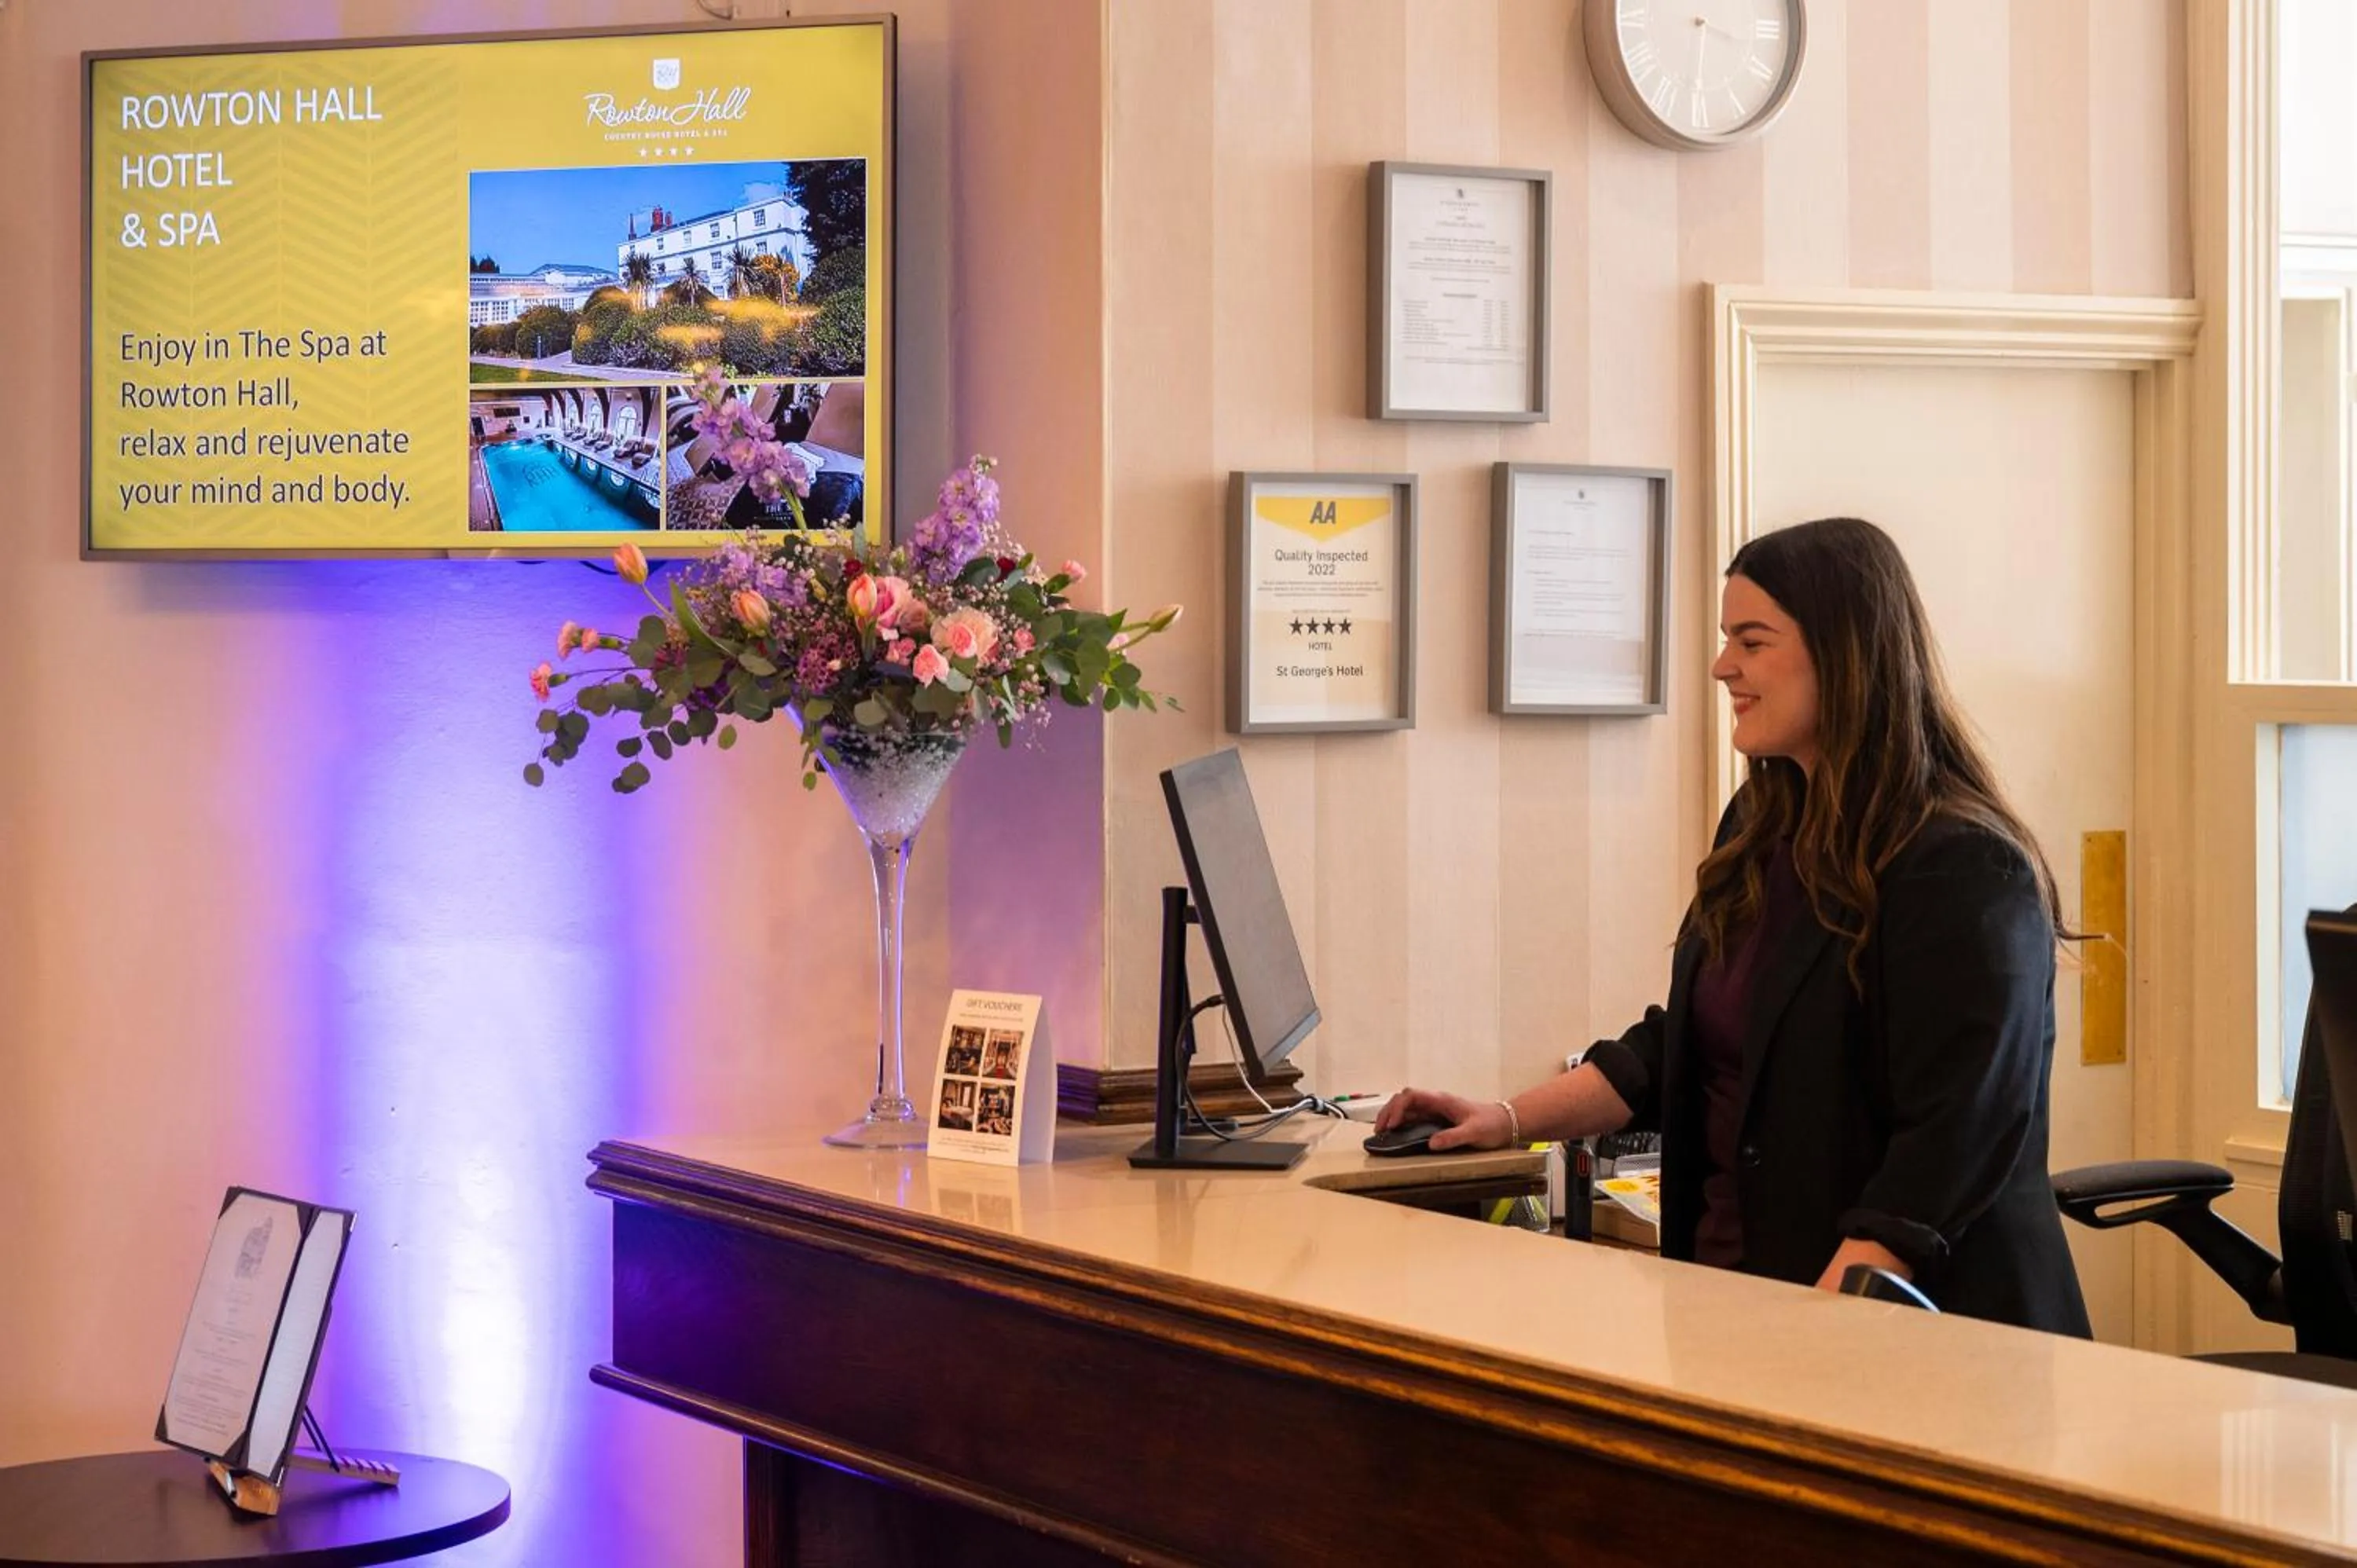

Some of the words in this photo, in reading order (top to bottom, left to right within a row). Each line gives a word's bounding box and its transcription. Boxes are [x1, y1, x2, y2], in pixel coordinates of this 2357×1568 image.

[121, 90, 280, 130] ROWTON
[295, 86, 383, 123] HALL
[583, 93, 669, 127] Rowton
[669, 87, 751, 126] Hall
[121, 152, 233, 189] HOTEL
[120, 213, 147, 247] &
[158, 211, 221, 247] SPA
[120, 333, 196, 367] Enjoy
[204, 332, 229, 359] in
[239, 331, 291, 358] The
[299, 330, 350, 363] Spa
[361, 330, 387, 356] at
[121, 381, 226, 408] Rowton
[237, 378, 299, 410] Hall,
[120, 430, 186, 456] relax
[196, 427, 246, 455] and
[257, 427, 409, 461] rejuvenate
[119, 482, 181, 511] your
[192, 476, 262, 504] mind
[272, 474, 324, 503] and
[334, 474, 410, 510] body.
[1310, 501, 1336, 524] AA
[1274, 549, 1313, 562] Quality
[1317, 550, 1368, 562] Inspected
[1308, 564, 1336, 575] 2022
[1308, 643, 1332, 651] HOTEL
[1277, 666, 1288, 676] St
[1291, 665, 1334, 678] George's
[1336, 665, 1363, 676] Hotel
